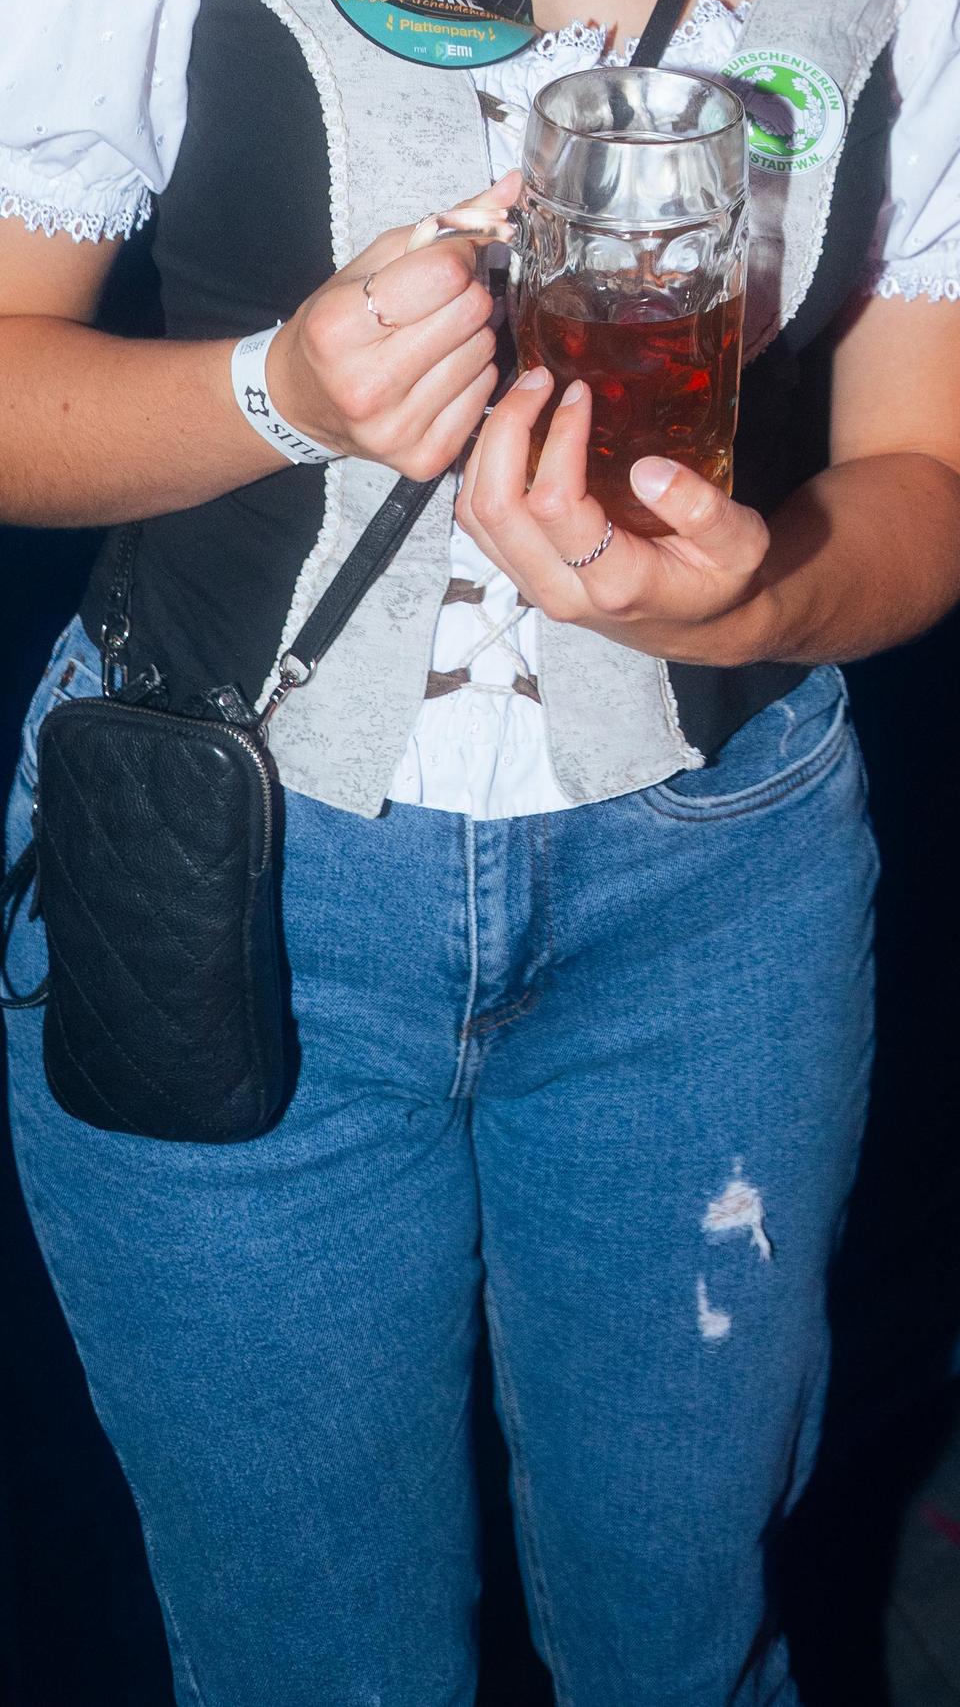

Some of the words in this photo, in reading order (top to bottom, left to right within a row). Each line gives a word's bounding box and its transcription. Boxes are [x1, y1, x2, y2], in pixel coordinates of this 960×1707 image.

[400, 19, 486, 42] Plattenparty
[414, 46, 427, 54] mit
[721, 51, 840, 111] BURSCHENVEREIN
[749, 151, 824, 172] STADT-W.N.
